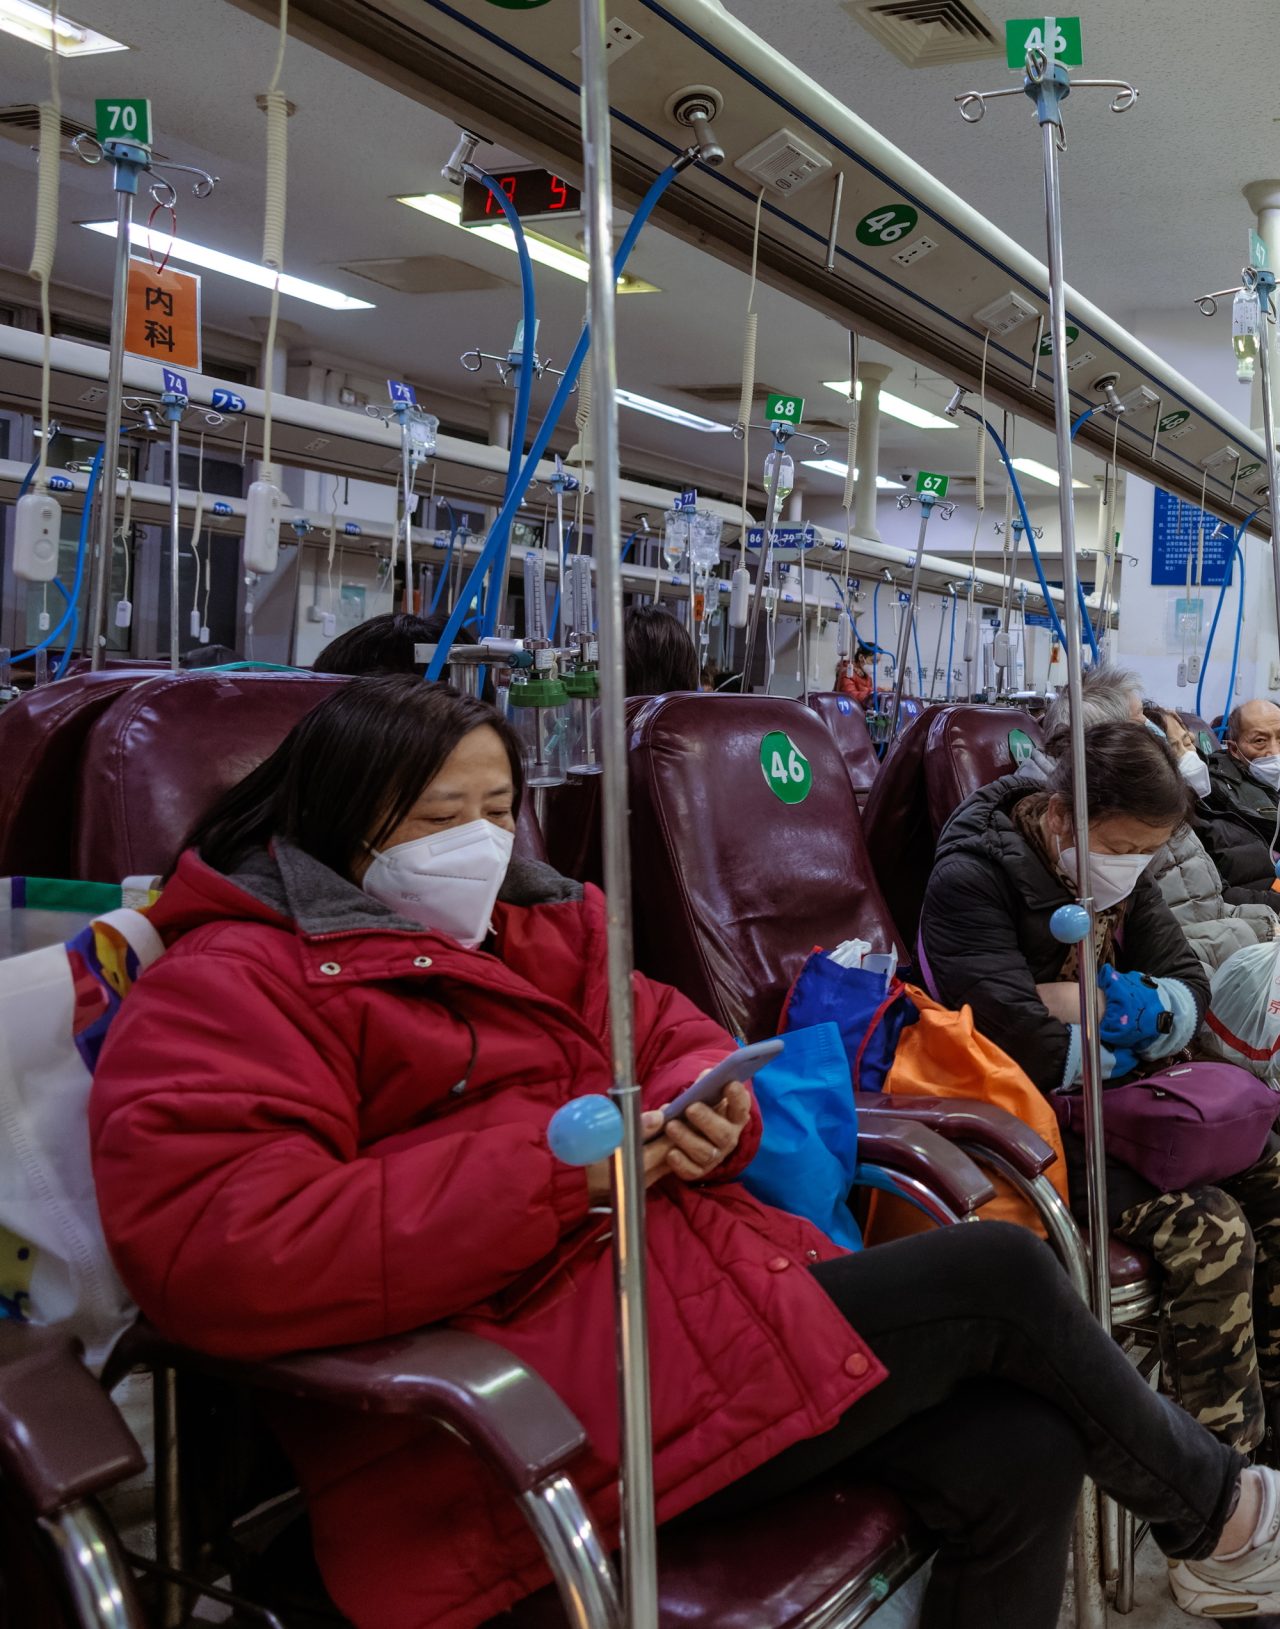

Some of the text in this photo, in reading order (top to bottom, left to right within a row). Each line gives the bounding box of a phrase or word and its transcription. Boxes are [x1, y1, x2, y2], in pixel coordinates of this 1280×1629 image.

[1024, 27, 1066, 54] 46
[107, 106, 137, 131] 70
[866, 212, 911, 242] 46
[144, 286, 175, 352] 内科
[168, 374, 183, 392] 74
[215, 392, 243, 412] 75
[774, 400, 795, 416] 68
[924, 477, 942, 490] 67
[684, 493, 692, 503] 77
[839, 701, 850, 712] 79
[907, 704, 917, 714] 80
[1016, 743, 1033, 762] 47
[771, 750, 804, 784] 46
